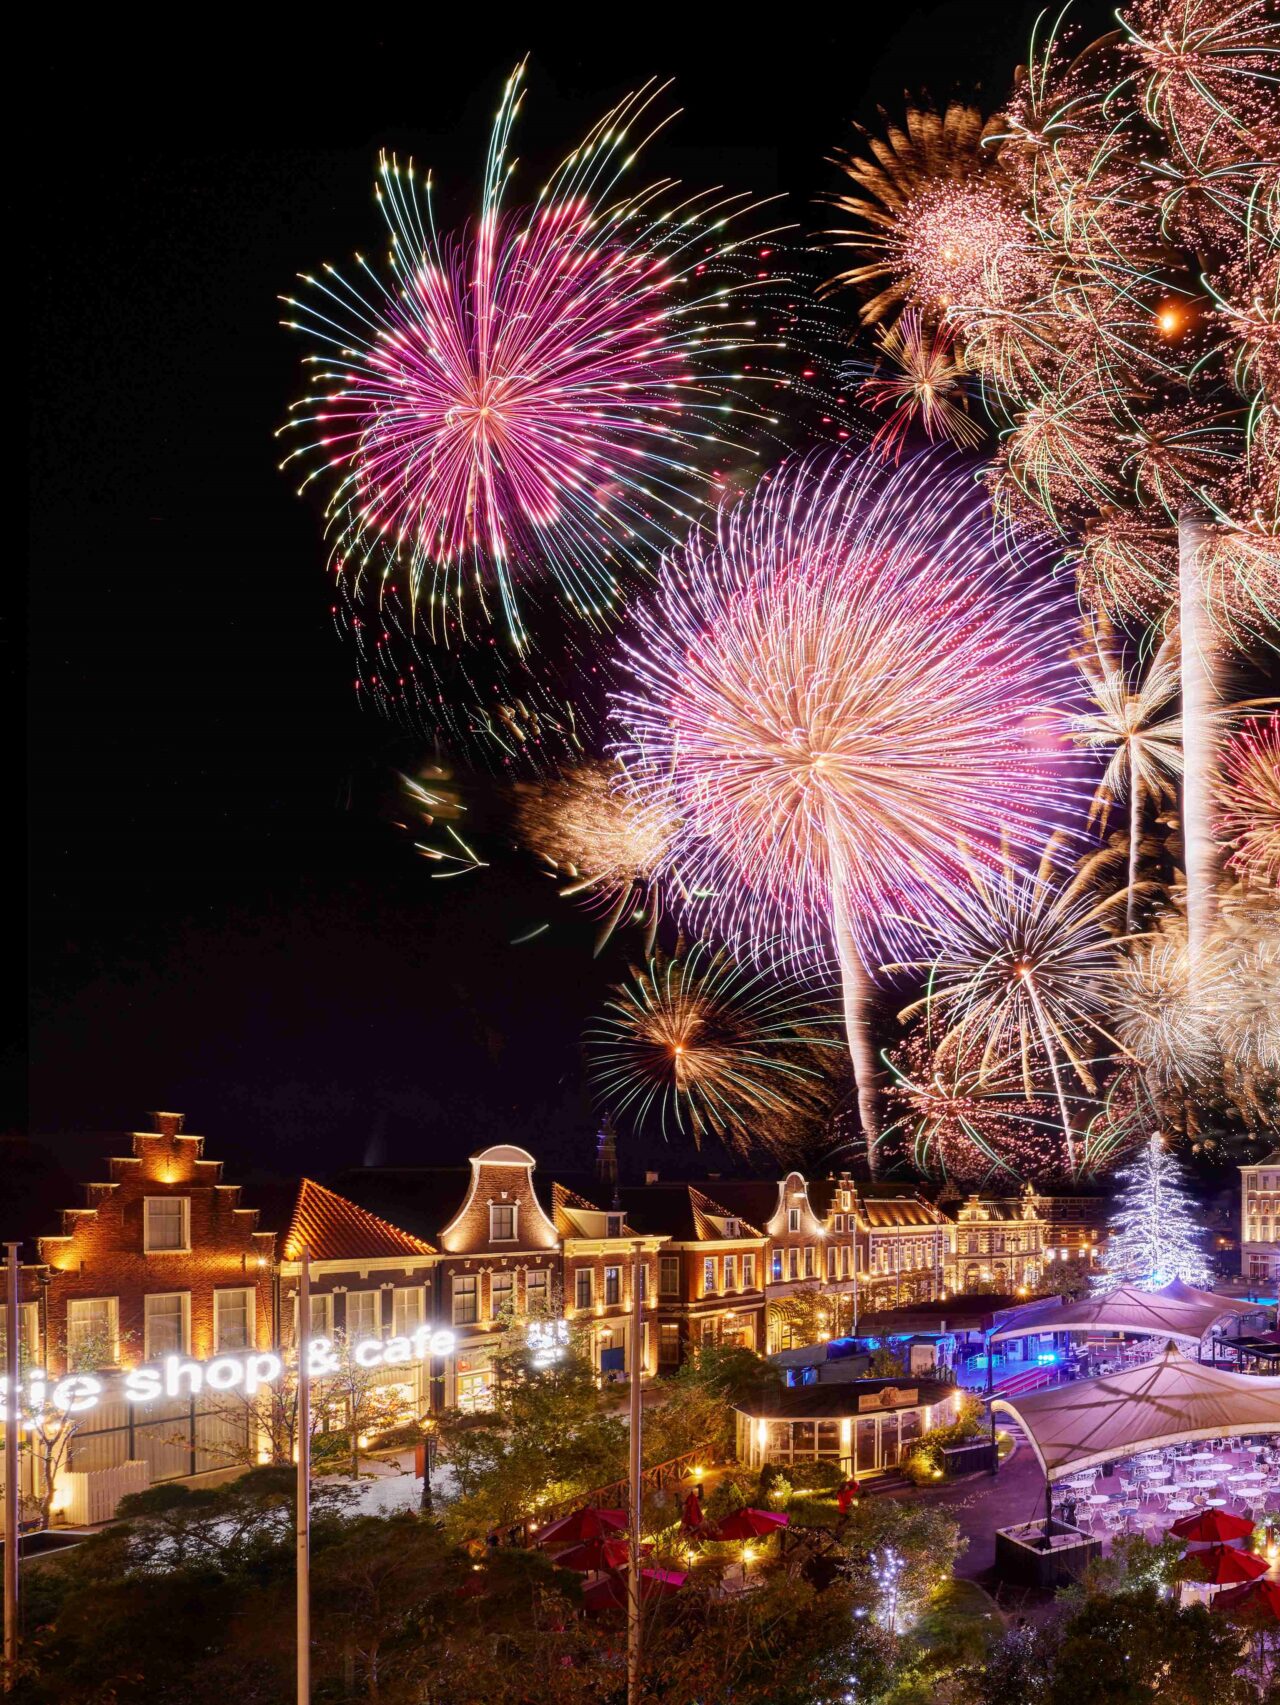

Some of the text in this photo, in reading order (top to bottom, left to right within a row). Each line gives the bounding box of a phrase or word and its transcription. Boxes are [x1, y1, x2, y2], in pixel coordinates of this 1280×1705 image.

[124, 1353, 281, 1401] shop
[308, 1338, 340, 1376] &
[355, 1325, 456, 1368] cafe
